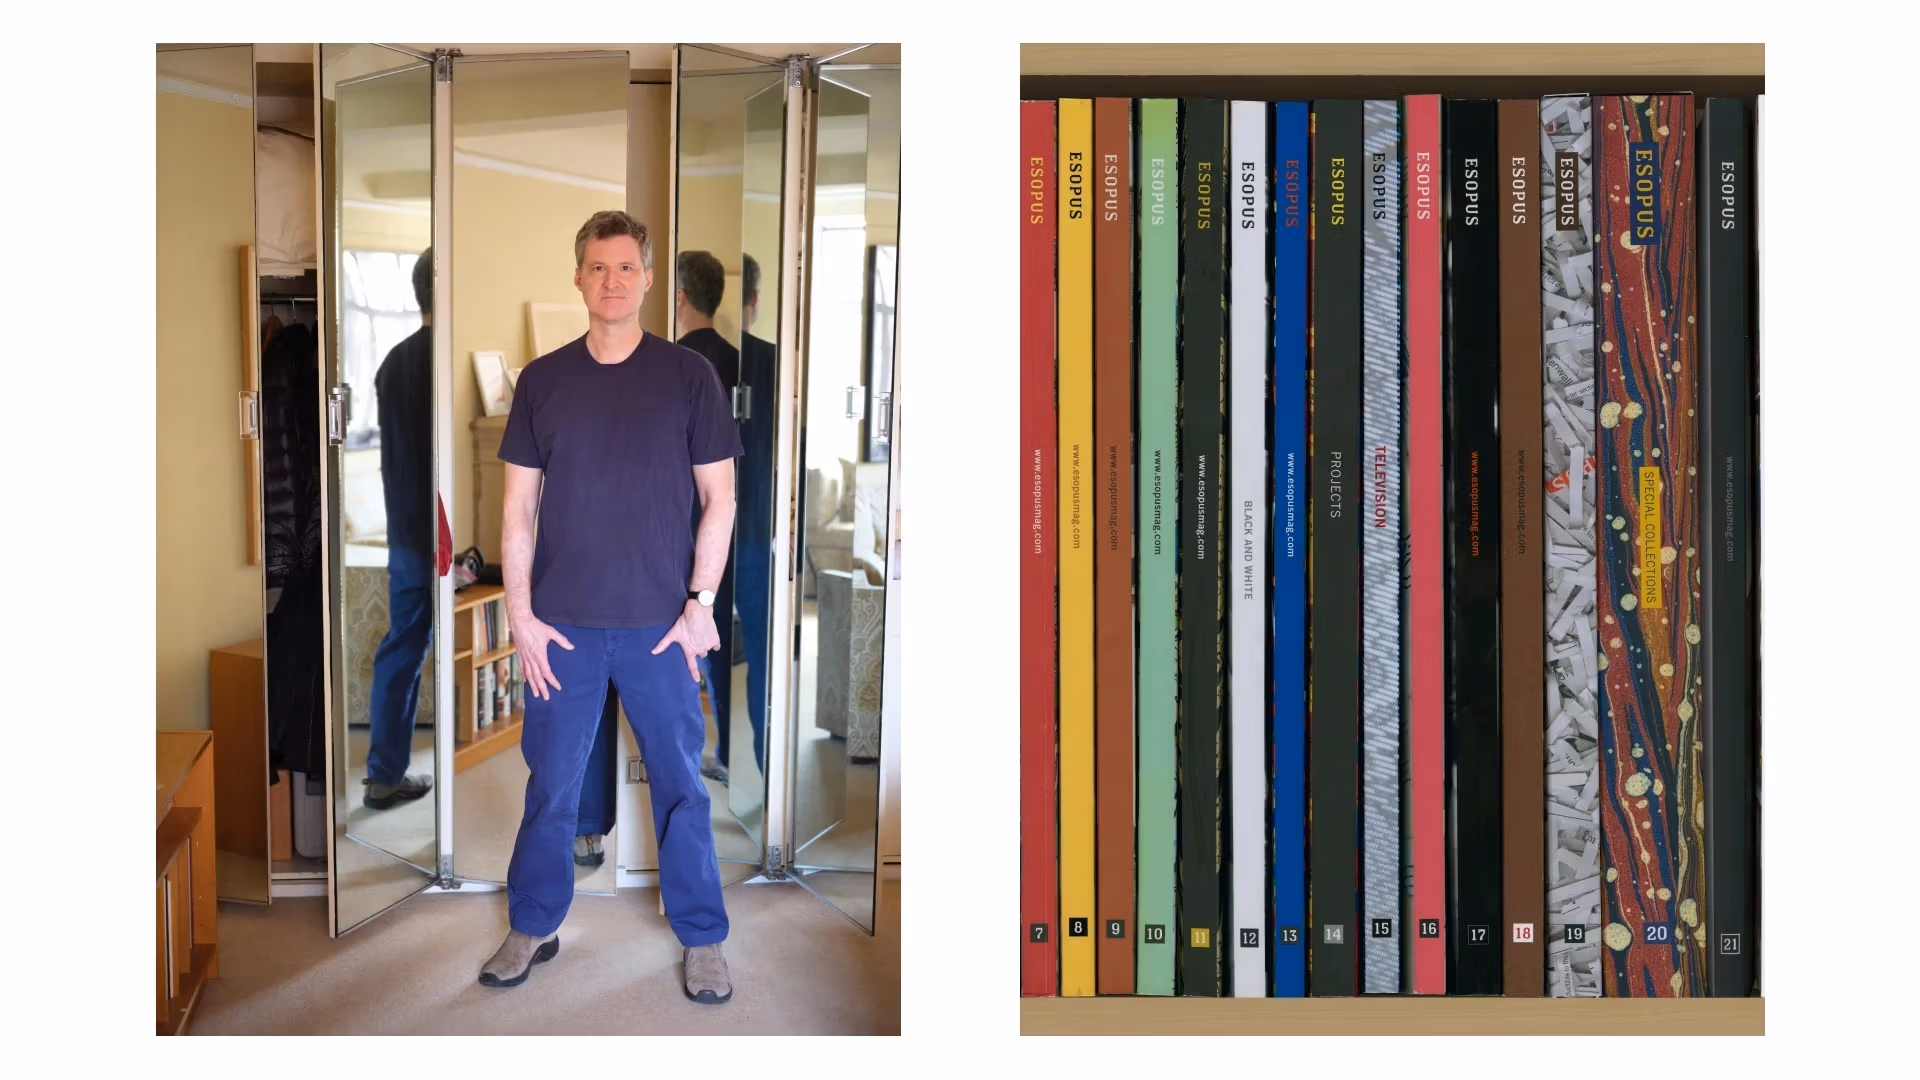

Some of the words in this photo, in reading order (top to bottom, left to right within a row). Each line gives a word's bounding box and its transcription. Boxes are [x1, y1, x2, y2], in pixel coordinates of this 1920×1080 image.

[1031, 157, 1043, 224] ESOPUS
[1070, 152, 1082, 219] ESOPUS
[1105, 155, 1117, 221] ESOPUS
[1152, 158, 1164, 225] ESOPUS
[1198, 162, 1211, 229] ESOPUS
[1242, 162, 1254, 229] ESOPUS
[1286, 159, 1299, 227] ESOPUS
[1332, 158, 1344, 225] ESOPUS
[1372, 152, 1385, 220] ESOPUS
[1417, 153, 1430, 219] ESOPUS
[1465, 159, 1478, 225] ESOPUS
[1513, 157, 1525, 224] ESOPUS
[1561, 158, 1574, 225] ESOPUS
[1636, 150, 1653, 238] ESOPUS
[1722, 162, 1734, 229] ESOPUS
[1033, 449, 1041, 553] www.esopusmag.com
[1072, 445, 1080, 548] www.esopusmag.com
[1110, 446, 1119, 550] www.esopusmag.com
[1153, 450, 1161, 554] www.esopusmag.com
[1196, 455, 1205, 559] www.esopusmag.com
[1244, 501, 1253, 536] BLACK
[1286, 453, 1294, 556] www.esopusmag.com
[1331, 452, 1342, 518] PROJECTS
[1375, 446, 1386, 528] TELEVISION
[1470, 452, 1478, 556] www.esopusmag.com
[1517, 449, 1526, 554] www.esopusmag.com
[1644, 471, 1656, 520] SPECIAL
[1725, 457, 1734, 561] www.esopusmag.com
[1244, 540, 1253, 561] AND
[1646, 524, 1656, 603] COLLECTIONS
[1036, 928, 1042, 939] 7
[1075, 922, 1082, 933] 8
[1112, 923, 1119, 934] 9
[1148, 928, 1162, 939] 10
[1194, 932, 1205, 943] 11
[1244, 933, 1256, 944] 12
[1284, 930, 1296, 941] 13
[1327, 929, 1341, 940] 14
[1375, 923, 1389, 934] 15
[1422, 923, 1436, 934] 16
[1472, 929, 1485, 940] 17
[1517, 927, 1530, 939] 18
[1568, 928, 1582, 939] 19
[1647, 926, 1667, 940] 20
[1724, 938, 1736, 950] 21
